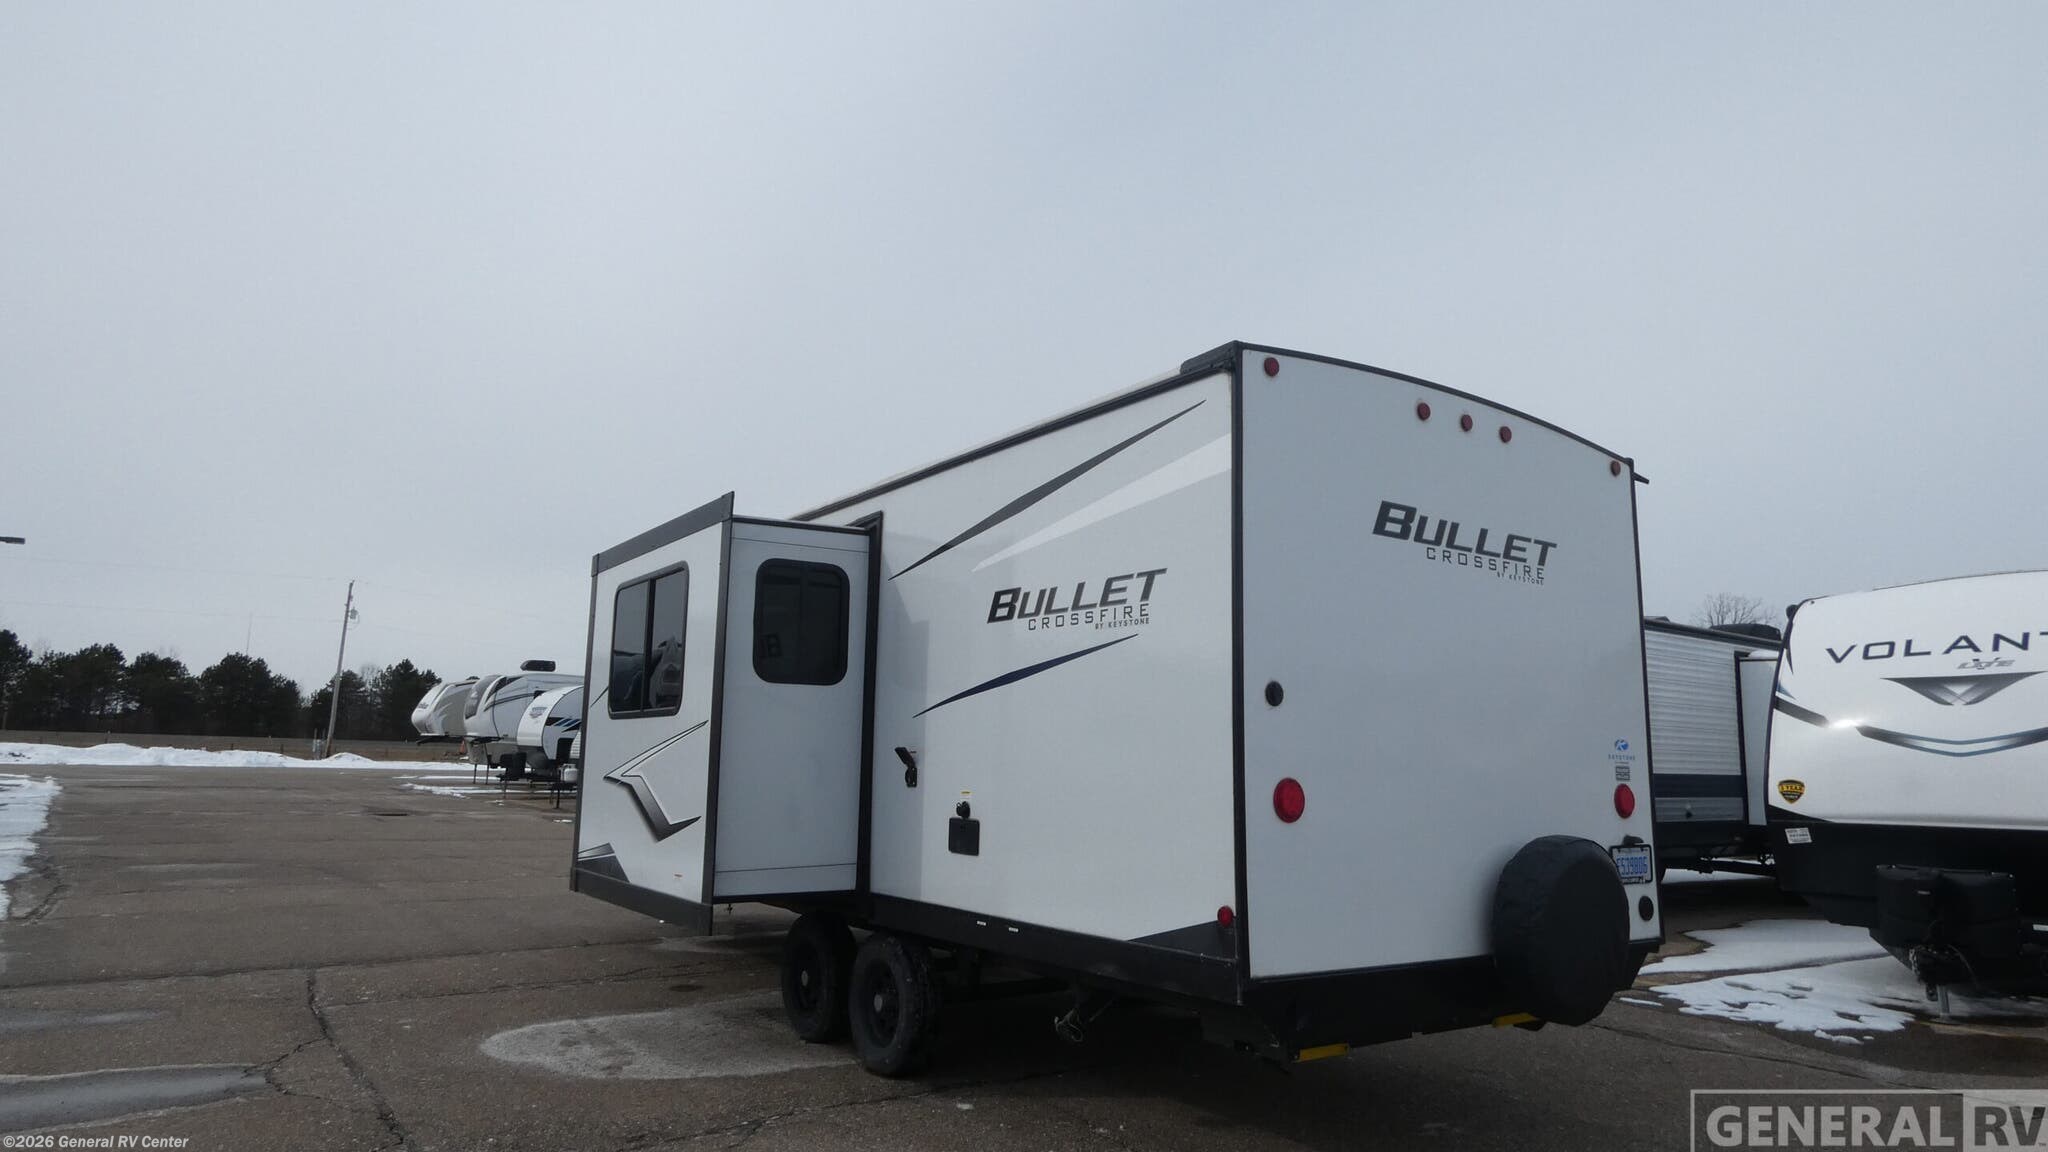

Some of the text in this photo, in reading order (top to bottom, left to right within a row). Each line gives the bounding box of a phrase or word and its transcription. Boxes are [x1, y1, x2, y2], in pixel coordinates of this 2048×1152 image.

[1372, 500, 1557, 567] BULLET
[1426, 546, 1545, 580] CROSSFIRE
[987, 567, 1168, 624] BULLET
[1508, 574, 1544, 586] KEYSTONE
[1028, 603, 1150, 631] CROSSFIRE
[1095, 617, 1150, 630] BY KEYSTONE
[1825, 631, 2048, 664] VOLAN
